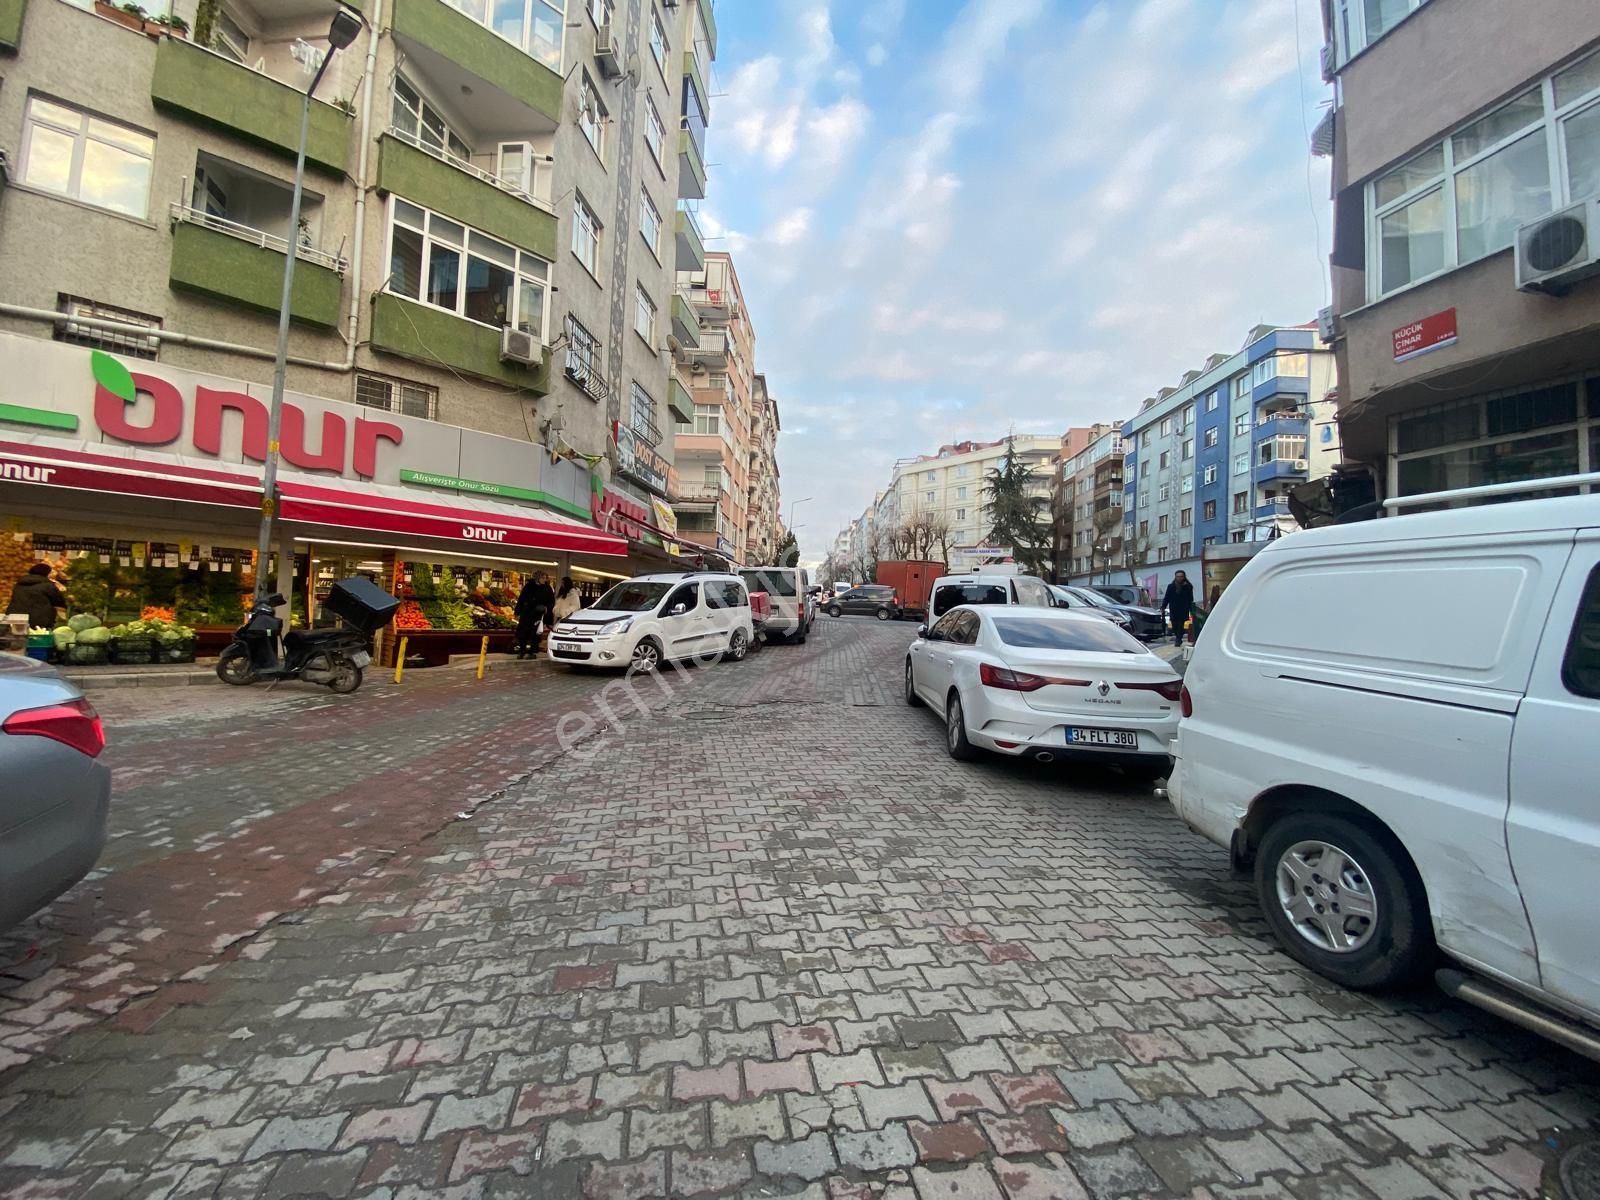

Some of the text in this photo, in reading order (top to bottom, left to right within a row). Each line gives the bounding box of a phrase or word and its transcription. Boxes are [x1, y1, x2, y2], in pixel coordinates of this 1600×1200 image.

[0, 465, 56, 482] nur
[459, 480, 478, 489] Onur
[1084, 697, 1122, 705] MEGANE
[1073, 729, 1134, 745] 34 FLT 380
